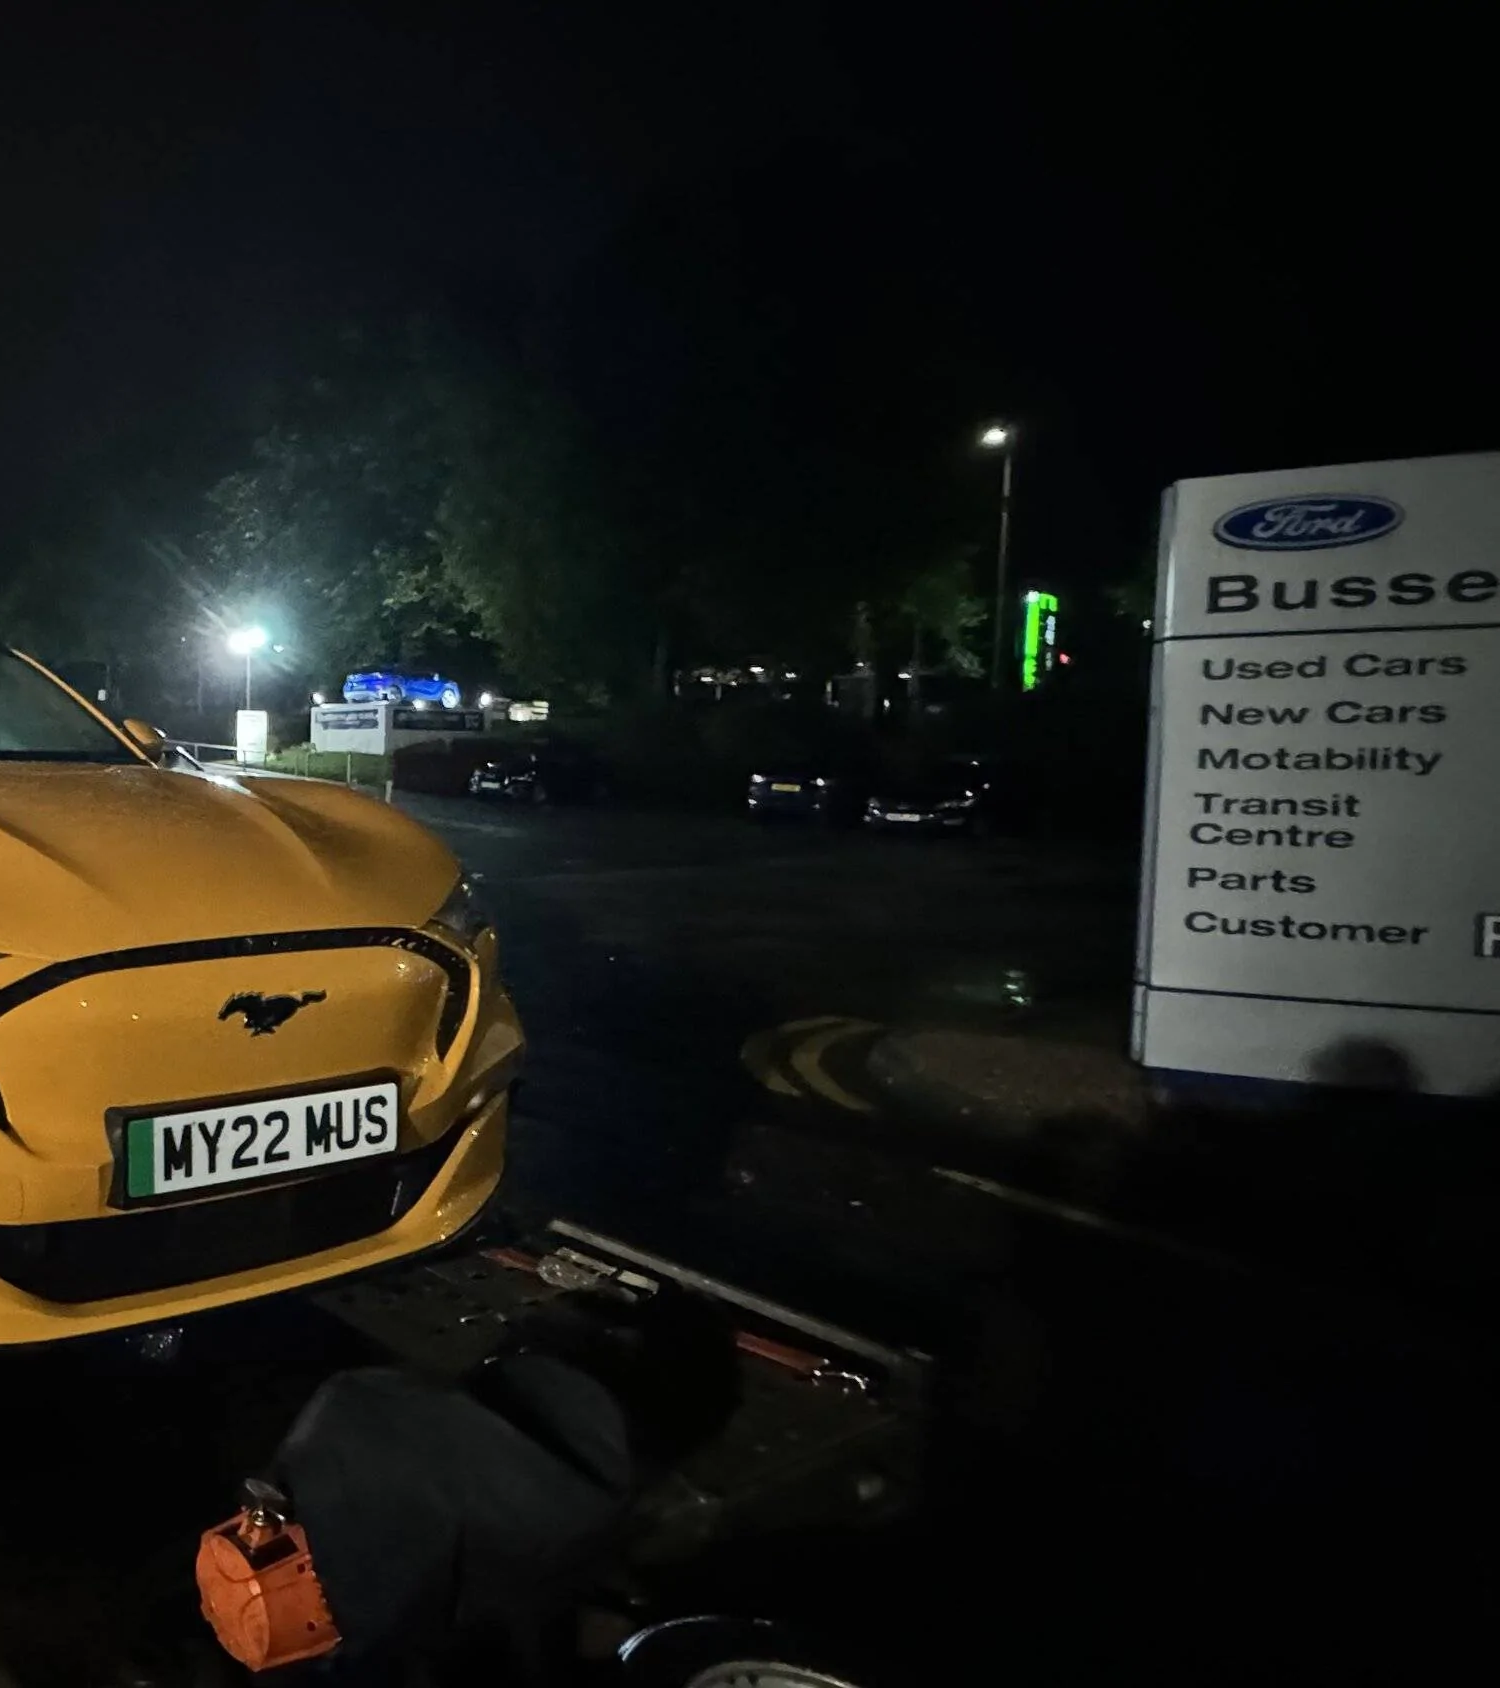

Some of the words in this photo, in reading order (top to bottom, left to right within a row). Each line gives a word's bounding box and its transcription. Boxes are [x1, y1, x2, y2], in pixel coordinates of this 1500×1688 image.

[1252, 503, 1367, 539] Ford
[1206, 569, 1500, 614] Busse
[1202, 655, 1328, 681] Used
[1343, 652, 1469, 678] Cars
[1200, 703, 1309, 727] New
[1326, 700, 1449, 726] Cars
[1197, 747, 1444, 777] Motability
[1194, 792, 1362, 818] Transit
[1190, 822, 1356, 850] Centre
[1188, 866, 1318, 895] Parts
[1184, 910, 1430, 946] Customer
[162, 1109, 290, 1182] MY22
[305, 1094, 389, 1157] MUS
